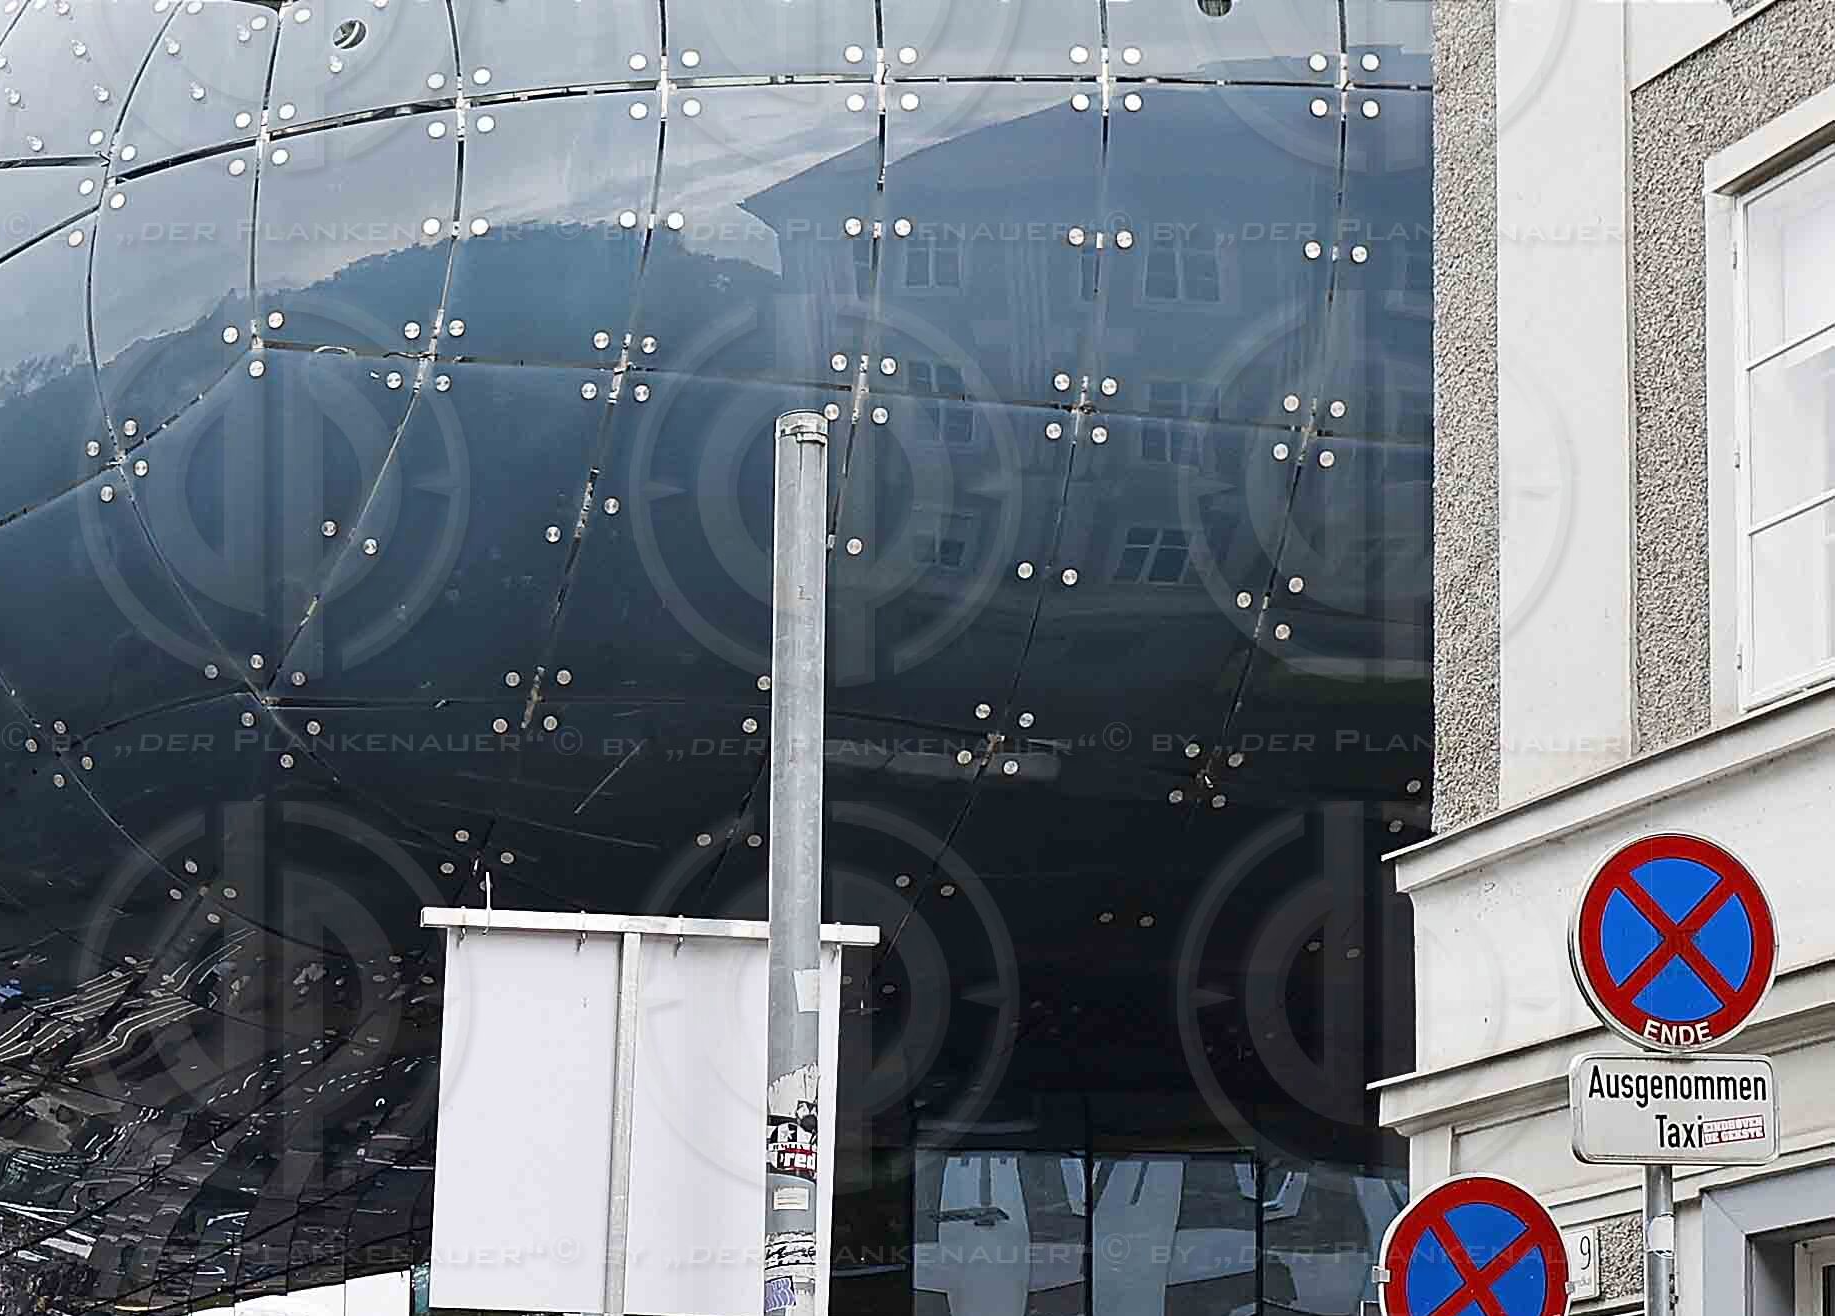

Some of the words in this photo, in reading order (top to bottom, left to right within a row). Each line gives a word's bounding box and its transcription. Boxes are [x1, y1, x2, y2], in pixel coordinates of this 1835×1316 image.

[1643, 1019, 1713, 1046] ENDE
[1588, 1065, 1766, 1107] Ausgenommen
[1655, 1114, 1704, 1148] Taxi
[1580, 1235, 1591, 1270] 9
